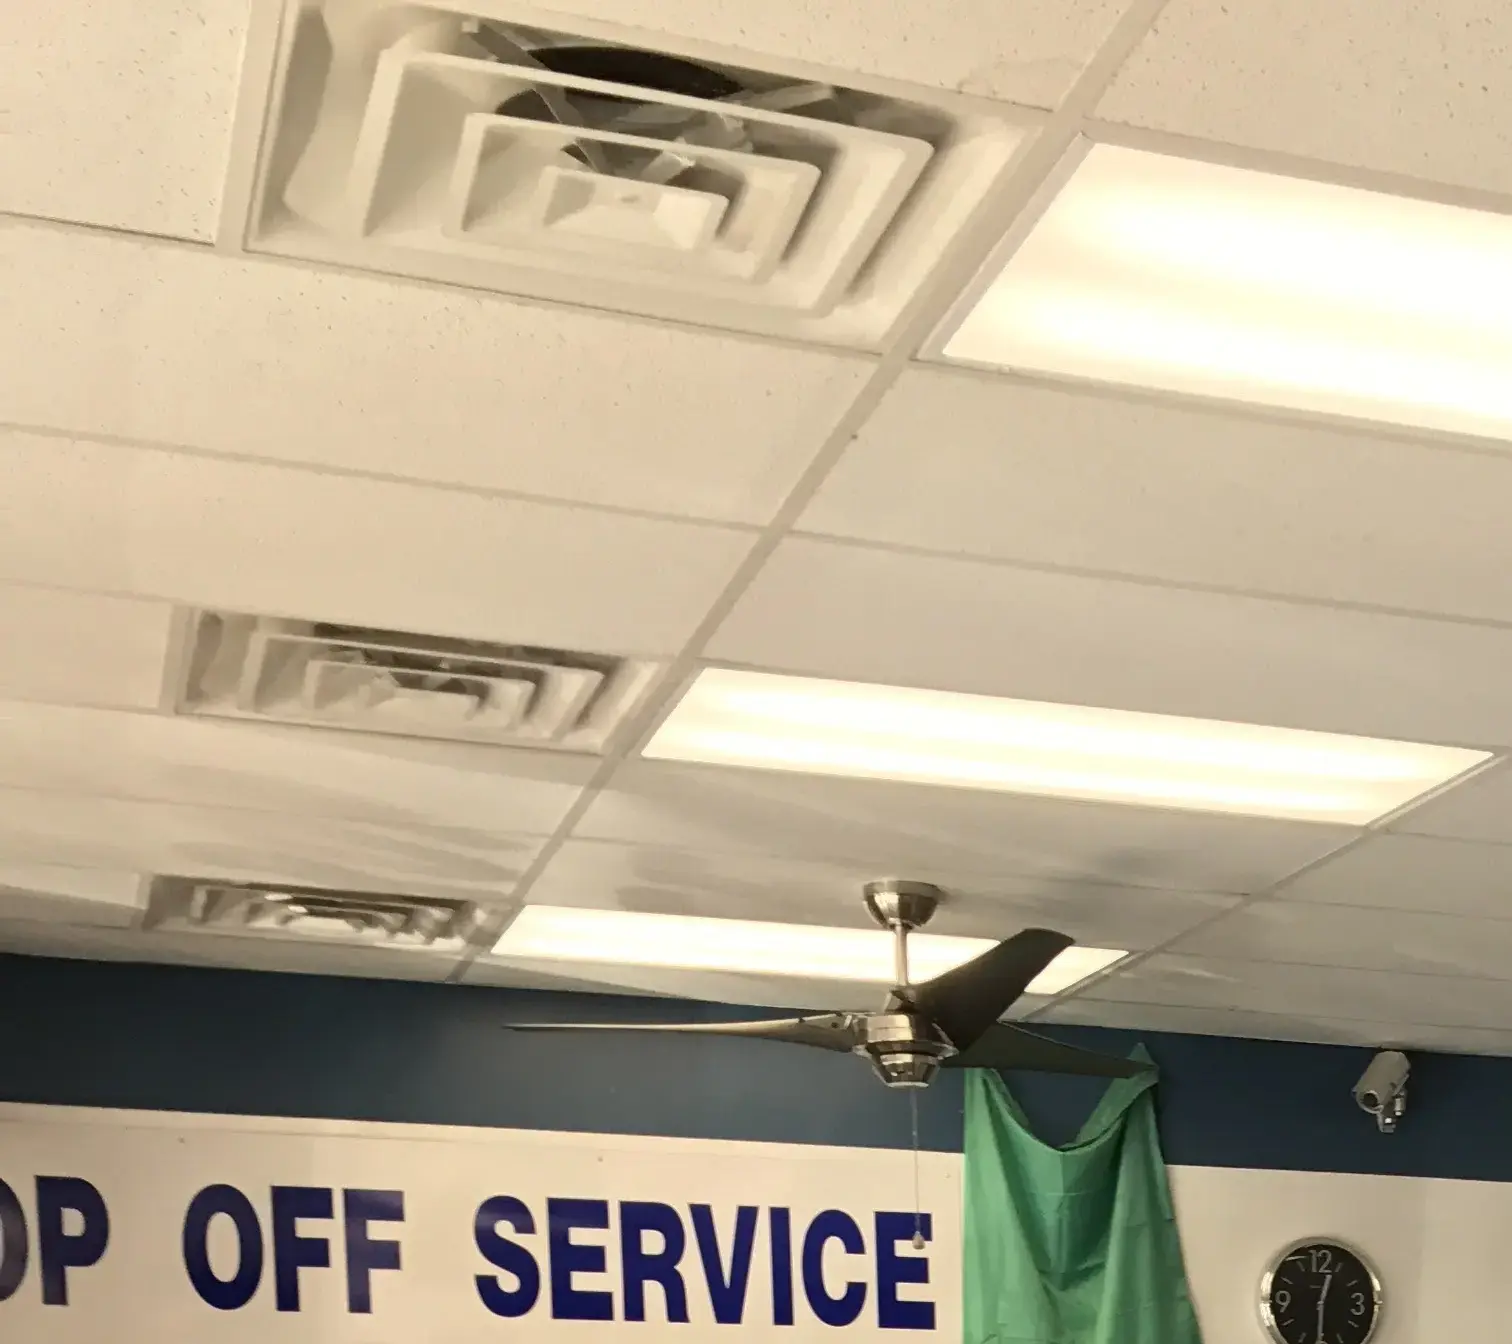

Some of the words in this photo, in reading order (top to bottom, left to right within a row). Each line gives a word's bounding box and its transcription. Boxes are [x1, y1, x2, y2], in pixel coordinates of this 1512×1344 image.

[182, 1183, 406, 1314] OFF
[474, 1195, 937, 1330] SERVICE
[1308, 1249, 1333, 1273] 12
[1275, 1290, 1291, 1313] 9
[1350, 1292, 1365, 1316] 3
